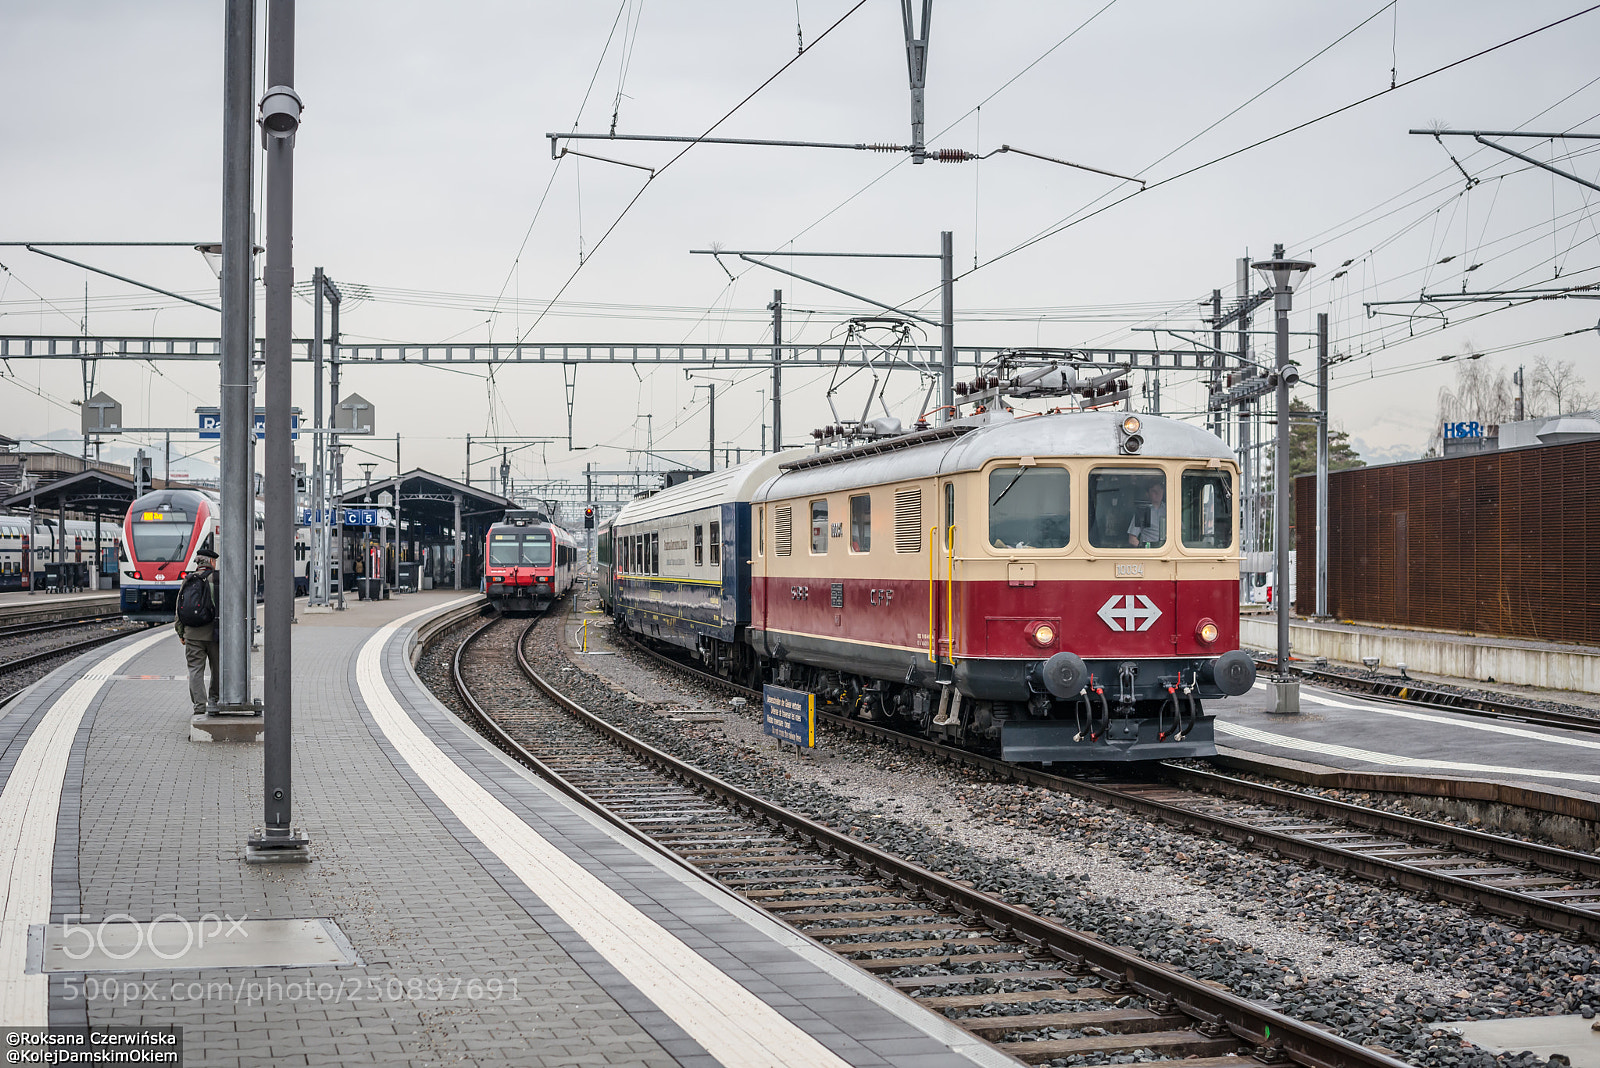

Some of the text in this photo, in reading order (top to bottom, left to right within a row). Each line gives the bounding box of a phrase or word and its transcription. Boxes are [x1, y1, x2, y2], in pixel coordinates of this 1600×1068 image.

[348, 514, 372, 523] C 5
[1117, 564, 1143, 575] 10034
[791, 585, 808, 601] SBB
[870, 588, 894, 607] CFF
